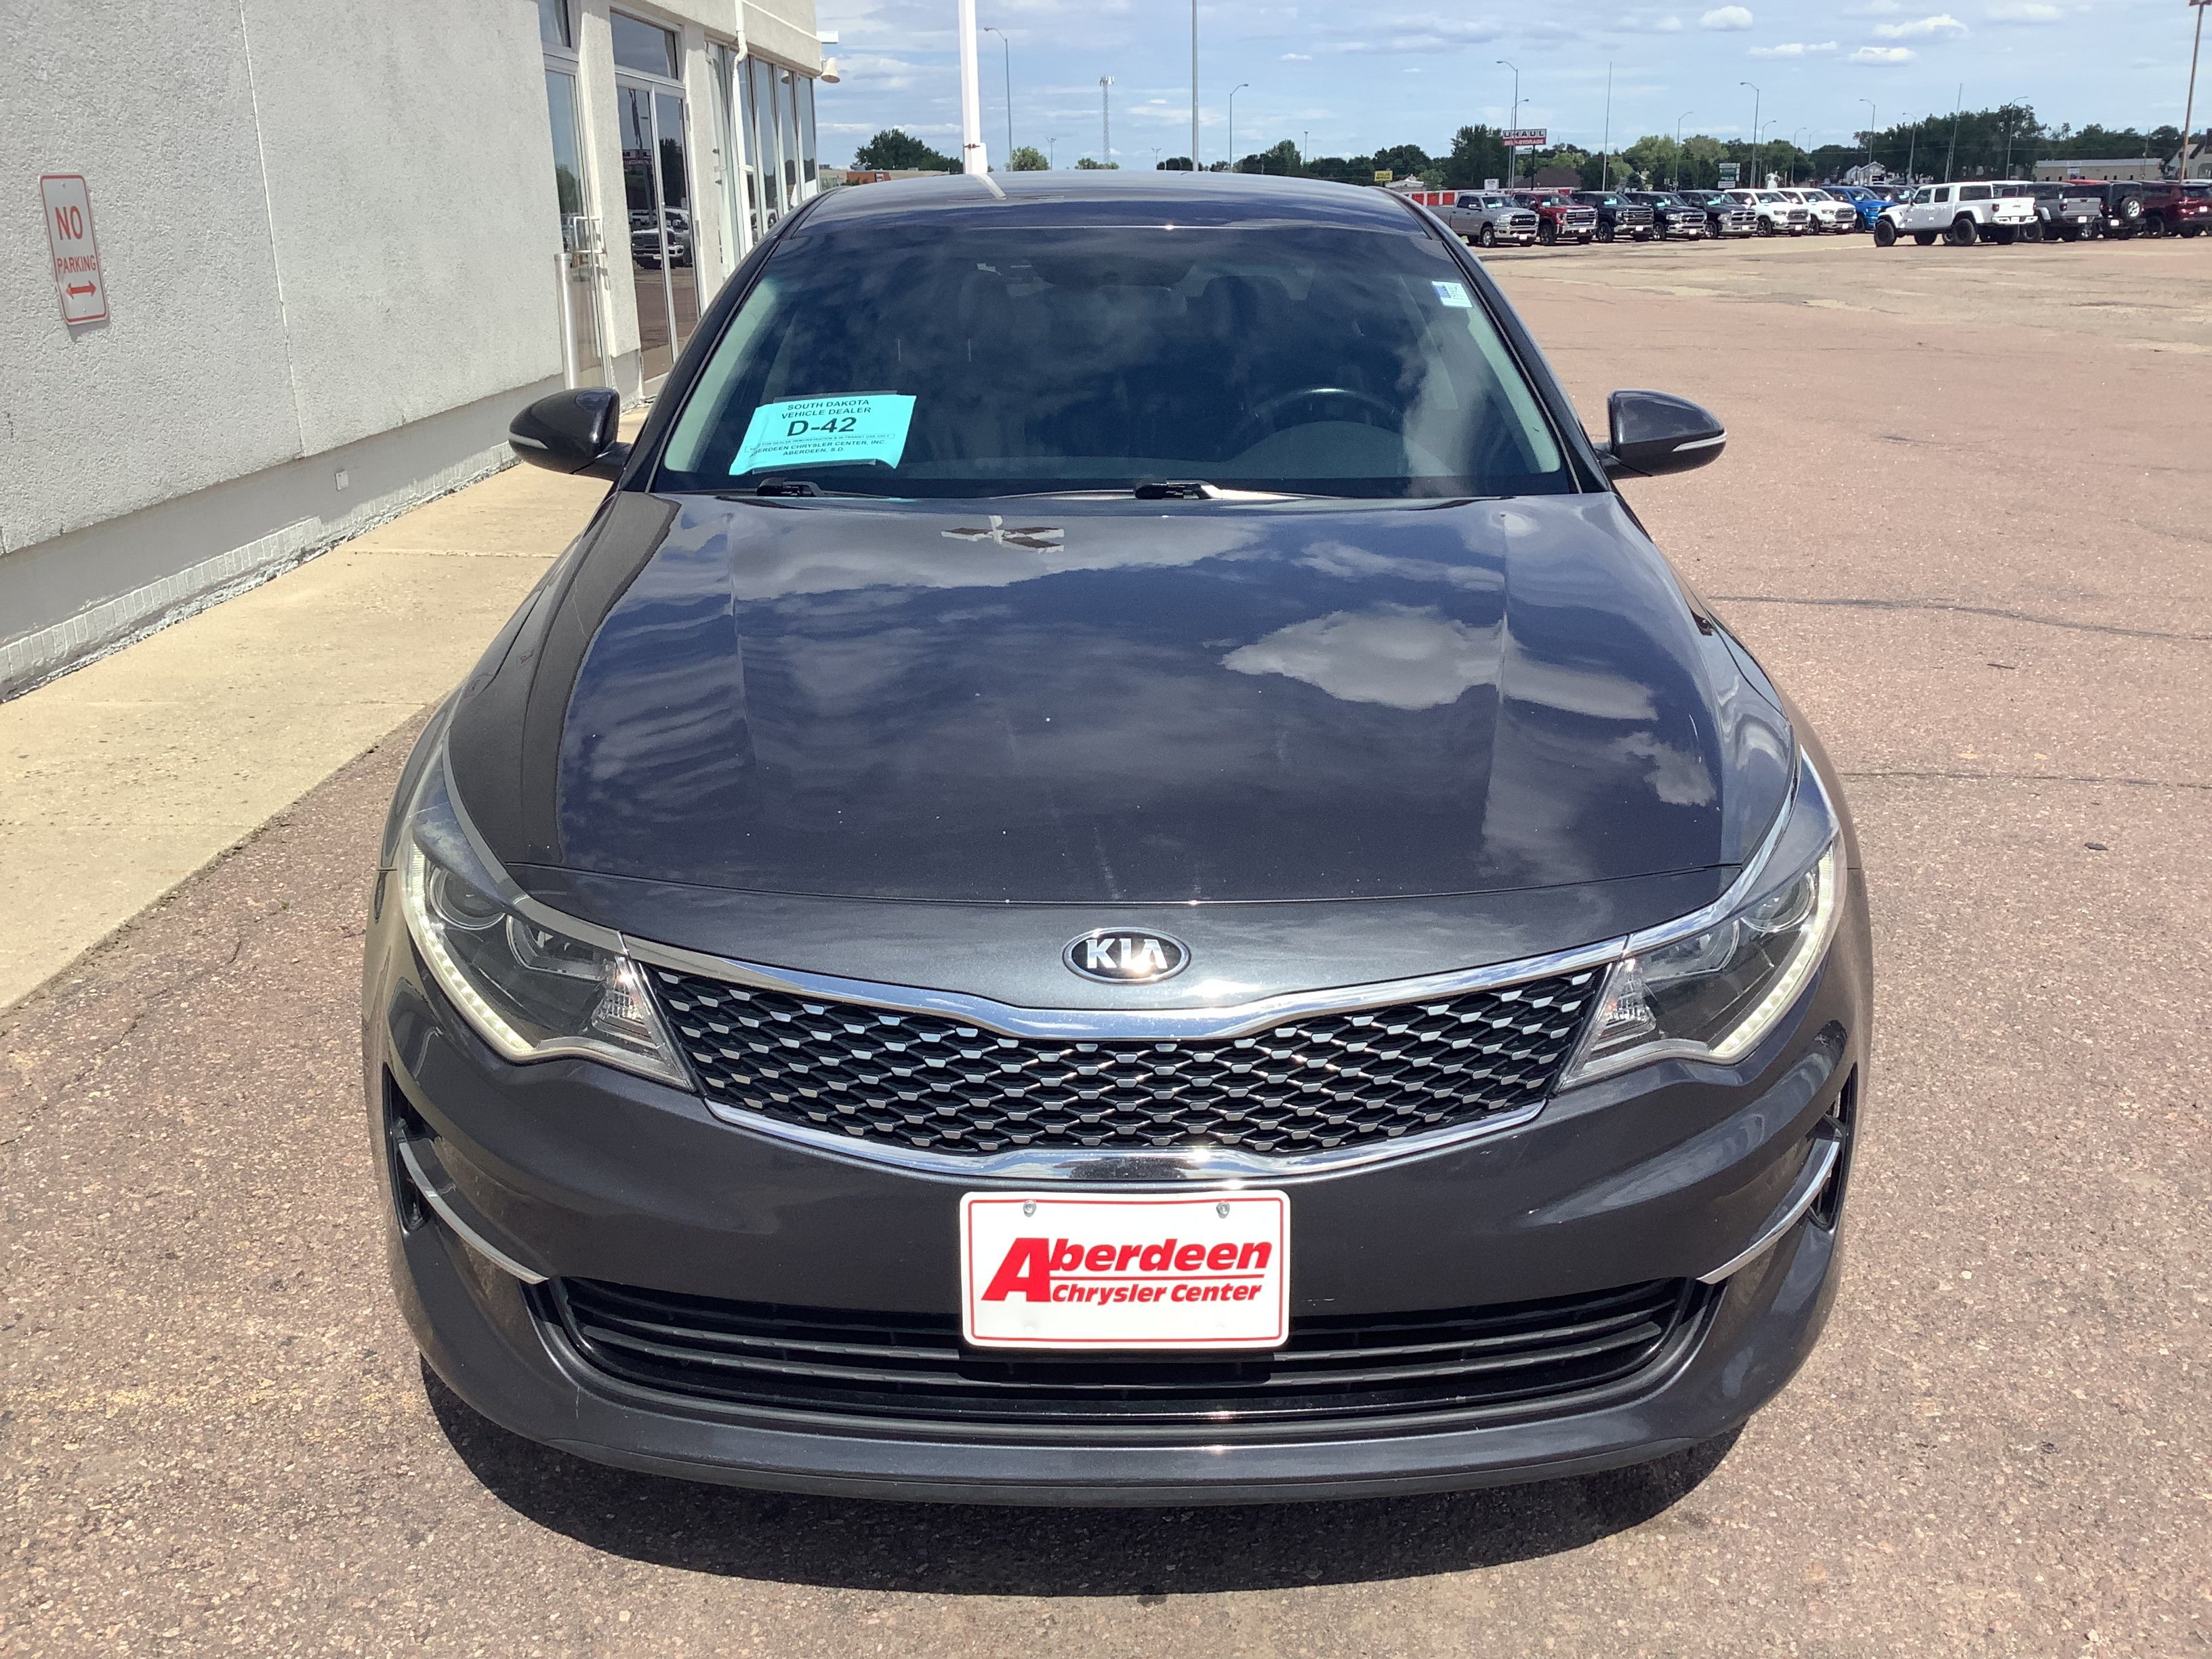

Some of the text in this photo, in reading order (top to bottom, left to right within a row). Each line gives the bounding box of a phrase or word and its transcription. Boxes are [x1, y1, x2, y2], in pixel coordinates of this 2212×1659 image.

[55, 205, 83, 240] NO
[58, 254, 97, 274] PARKING
[781, 407, 872, 419] VEHICLE DEALER
[787, 399, 869, 411] SOUTH DAKOTA
[787, 417, 857, 437] D-42
[791, 442, 832, 450] CHRYSLER
[1086, 938, 1168, 970] KIA
[981, 1237, 1273, 1303] Aberdeen
[1051, 1283, 1263, 1306] Chrysler Center
